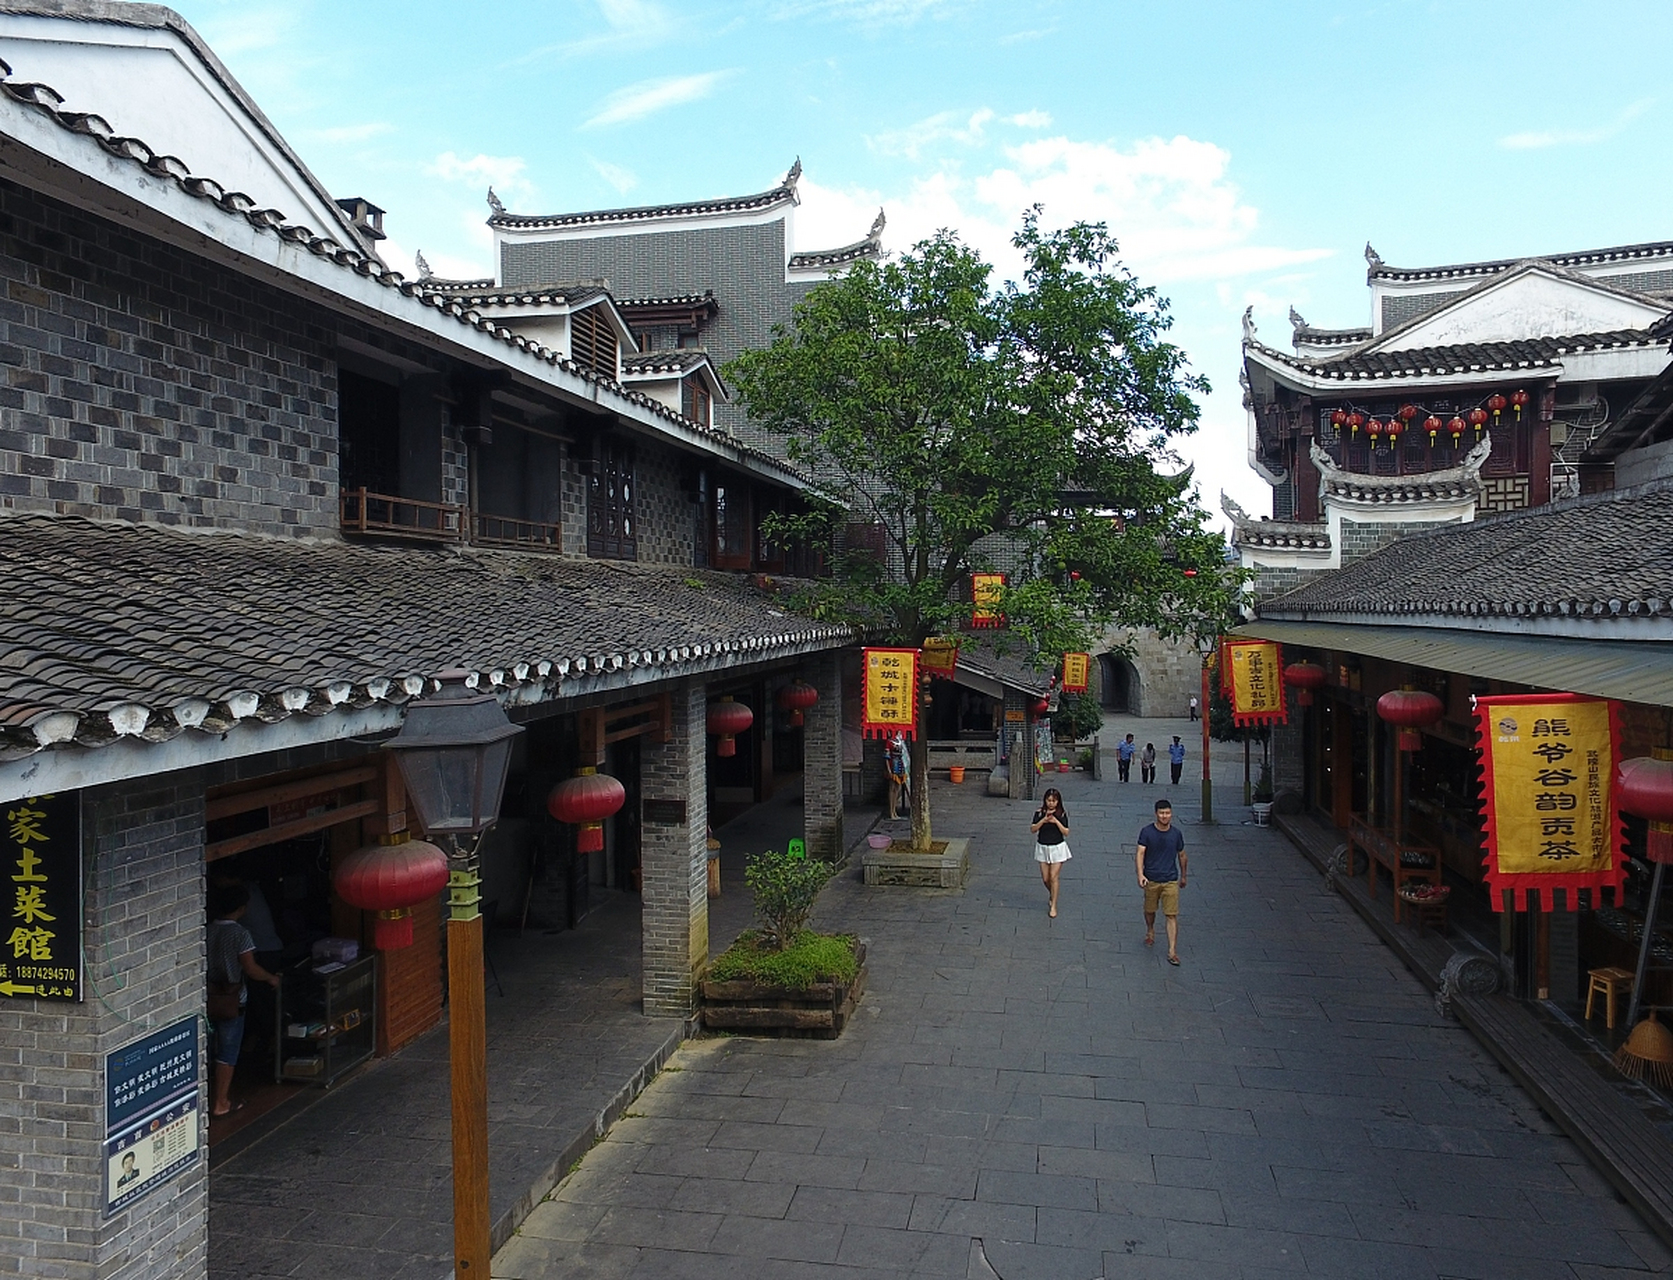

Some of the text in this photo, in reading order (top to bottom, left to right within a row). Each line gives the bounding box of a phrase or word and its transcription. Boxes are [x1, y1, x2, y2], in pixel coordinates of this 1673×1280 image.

[1531, 718, 1581, 861] 熊爷谷韵贡茶
[5, 794, 57, 961] 家土菜館
[16, 965, 76, 981] 18874294570
